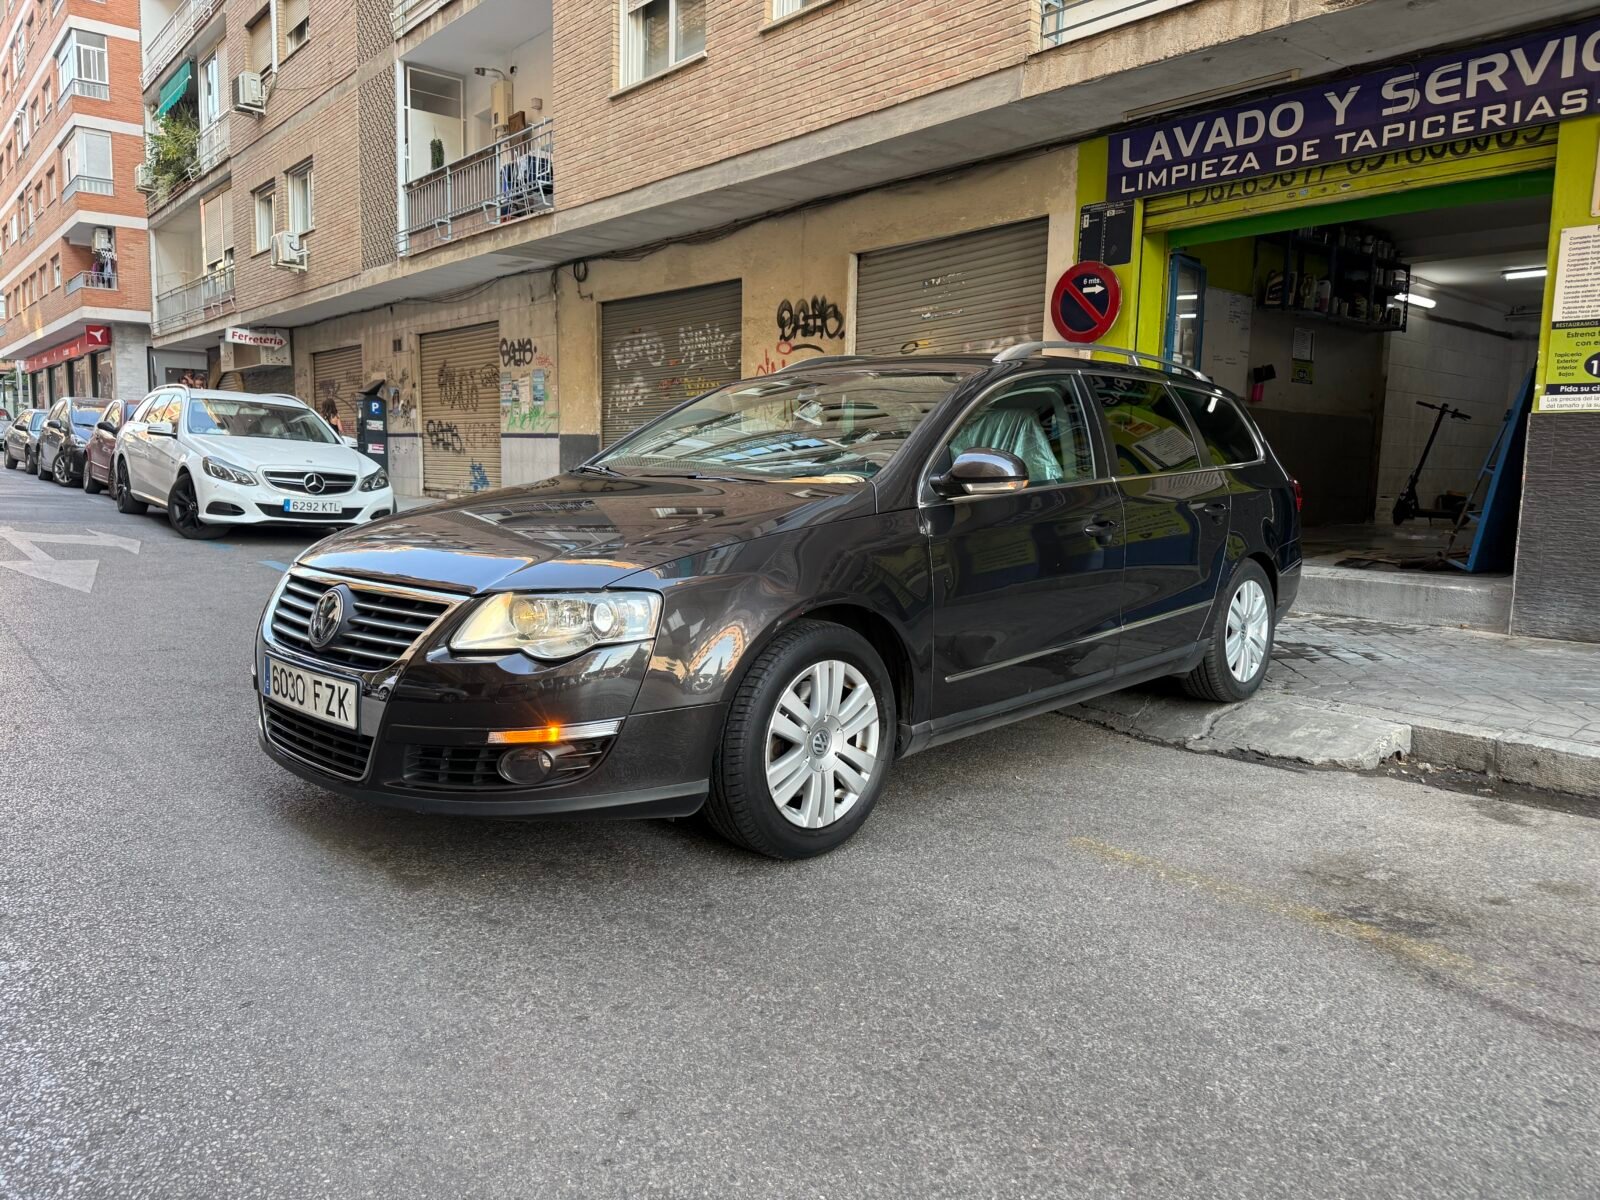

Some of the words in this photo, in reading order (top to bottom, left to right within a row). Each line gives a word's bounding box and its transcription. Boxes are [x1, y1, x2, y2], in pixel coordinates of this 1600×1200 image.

[1120, 151, 1261, 194] LIMPIEZA
[1275, 138, 1321, 167] DE
[1334, 88, 1589, 155] TAPICERIAS
[1121, 100, 1305, 168] LAVADO
[1324, 85, 1361, 126] Y
[1566, 331, 1596, 339] Estrena
[371, 402, 380, 412] P
[292, 501, 319, 511] 6292
[321, 502, 340, 512] KTL
[272, 664, 306, 706] 6030
[313, 679, 349, 721] FZK
